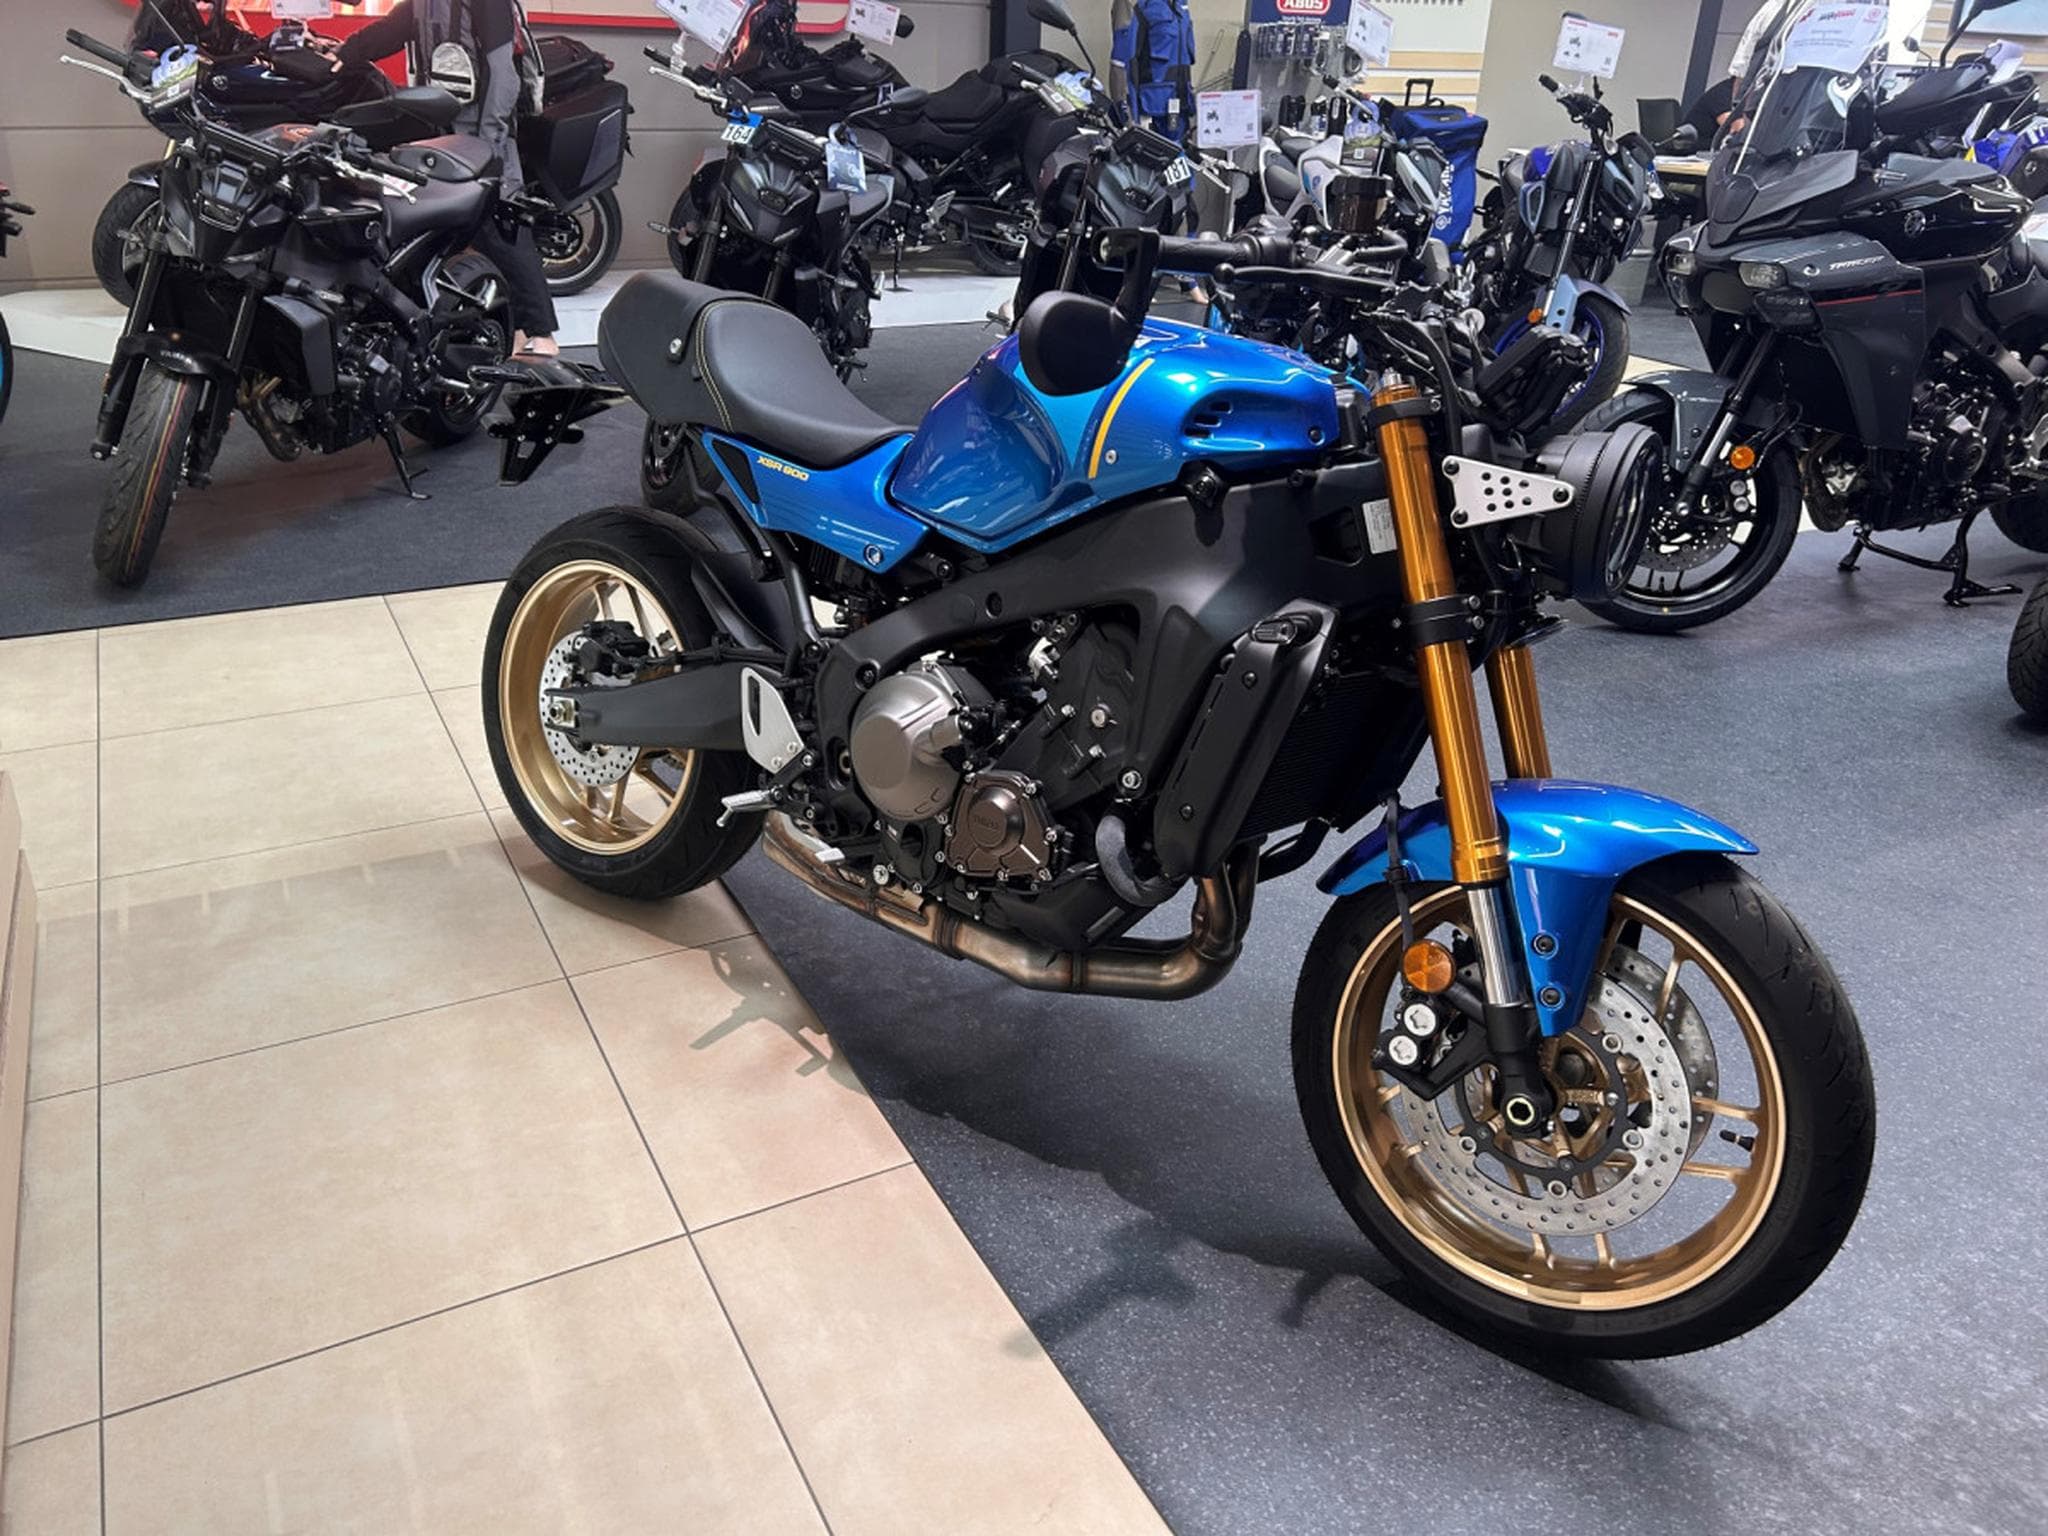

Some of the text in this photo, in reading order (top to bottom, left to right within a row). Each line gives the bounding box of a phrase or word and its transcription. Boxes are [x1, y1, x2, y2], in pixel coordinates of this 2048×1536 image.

[1282, 0, 1324, 9] ABUS
[724, 126, 754, 142] 164
[756, 455, 810, 482] XSR 900
